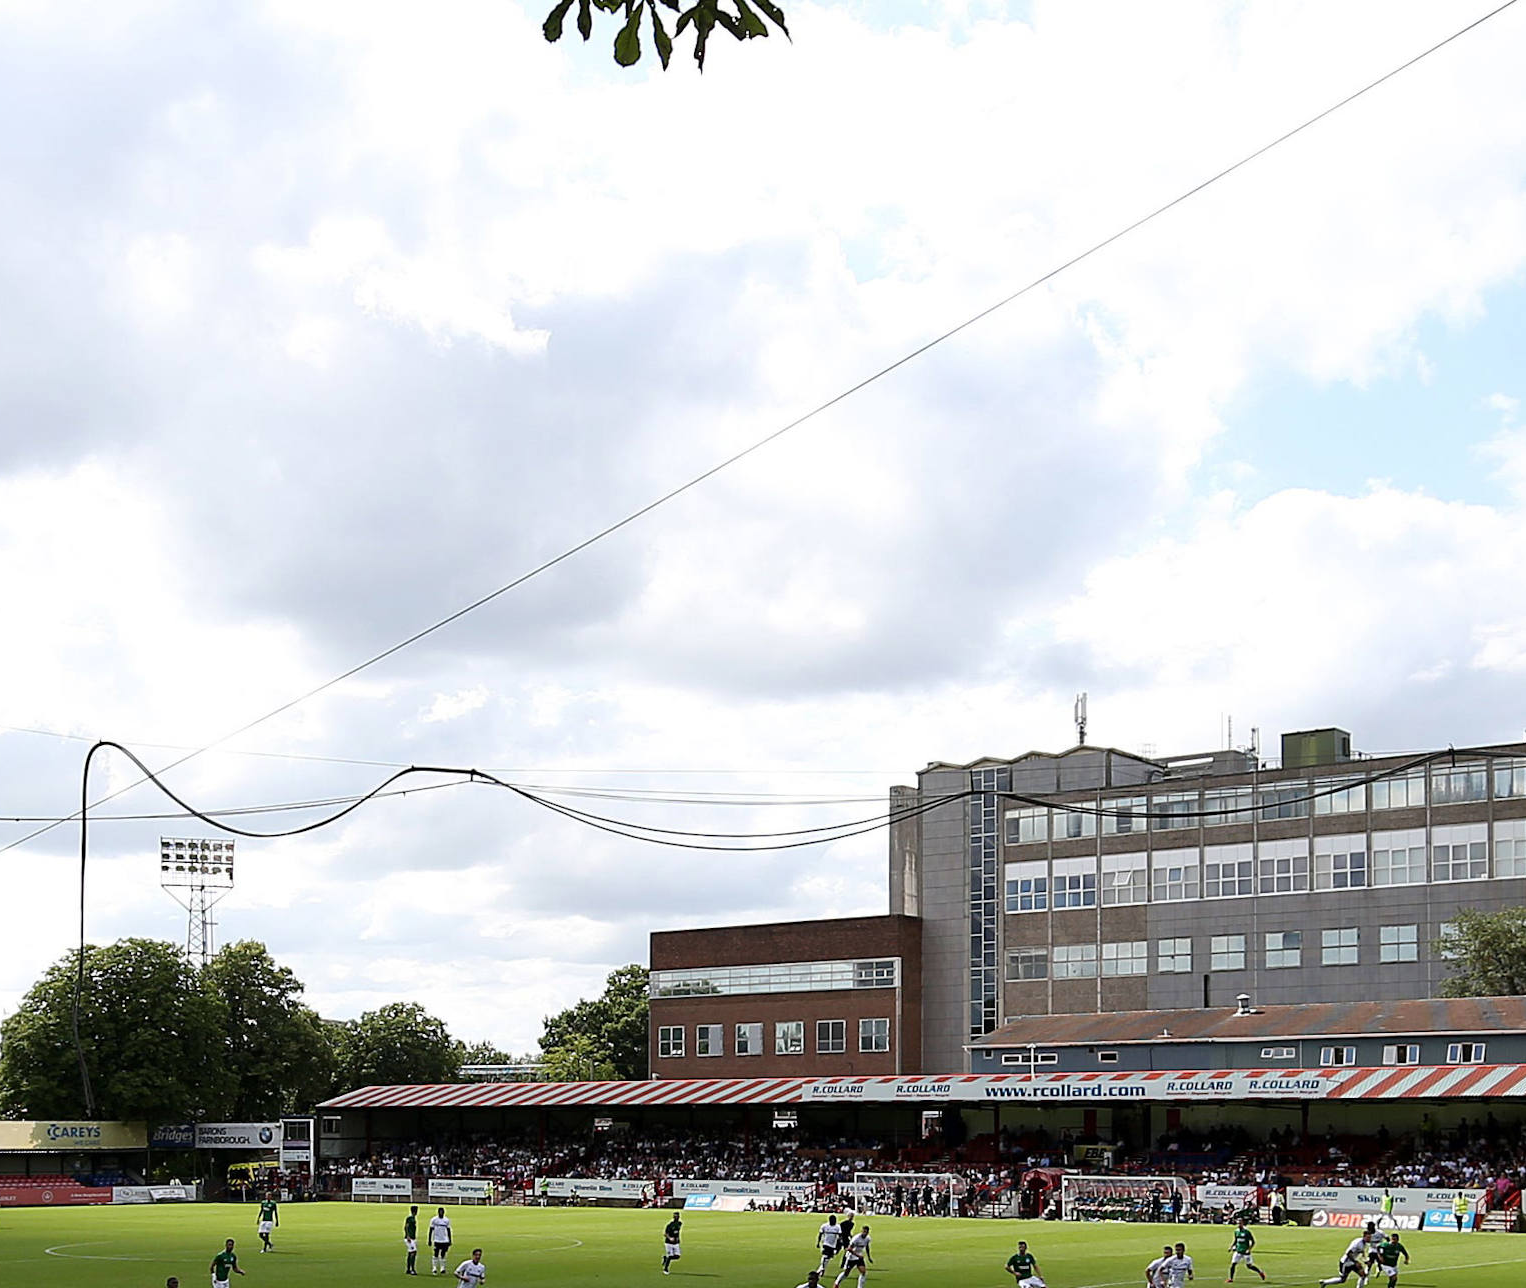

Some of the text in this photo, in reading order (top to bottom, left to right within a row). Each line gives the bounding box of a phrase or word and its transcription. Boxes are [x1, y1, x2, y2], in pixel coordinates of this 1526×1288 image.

[896, 1084, 951, 1093] R.COLLARD
[1167, 1081, 1233, 1091] R.COLLARD
[1249, 1080, 1320, 1089] R.COLLARD
[812, 1085, 864, 1094] R.COLLARD
[985, 1084, 1145, 1097] www.rcollard.com
[51, 1126, 101, 1138] CAREYS
[198, 1127, 227, 1136] BARONS
[153, 1130, 193, 1143] Bridges
[723, 1186, 760, 1194] Demolition
[1357, 1194, 1380, 1203] Skip
